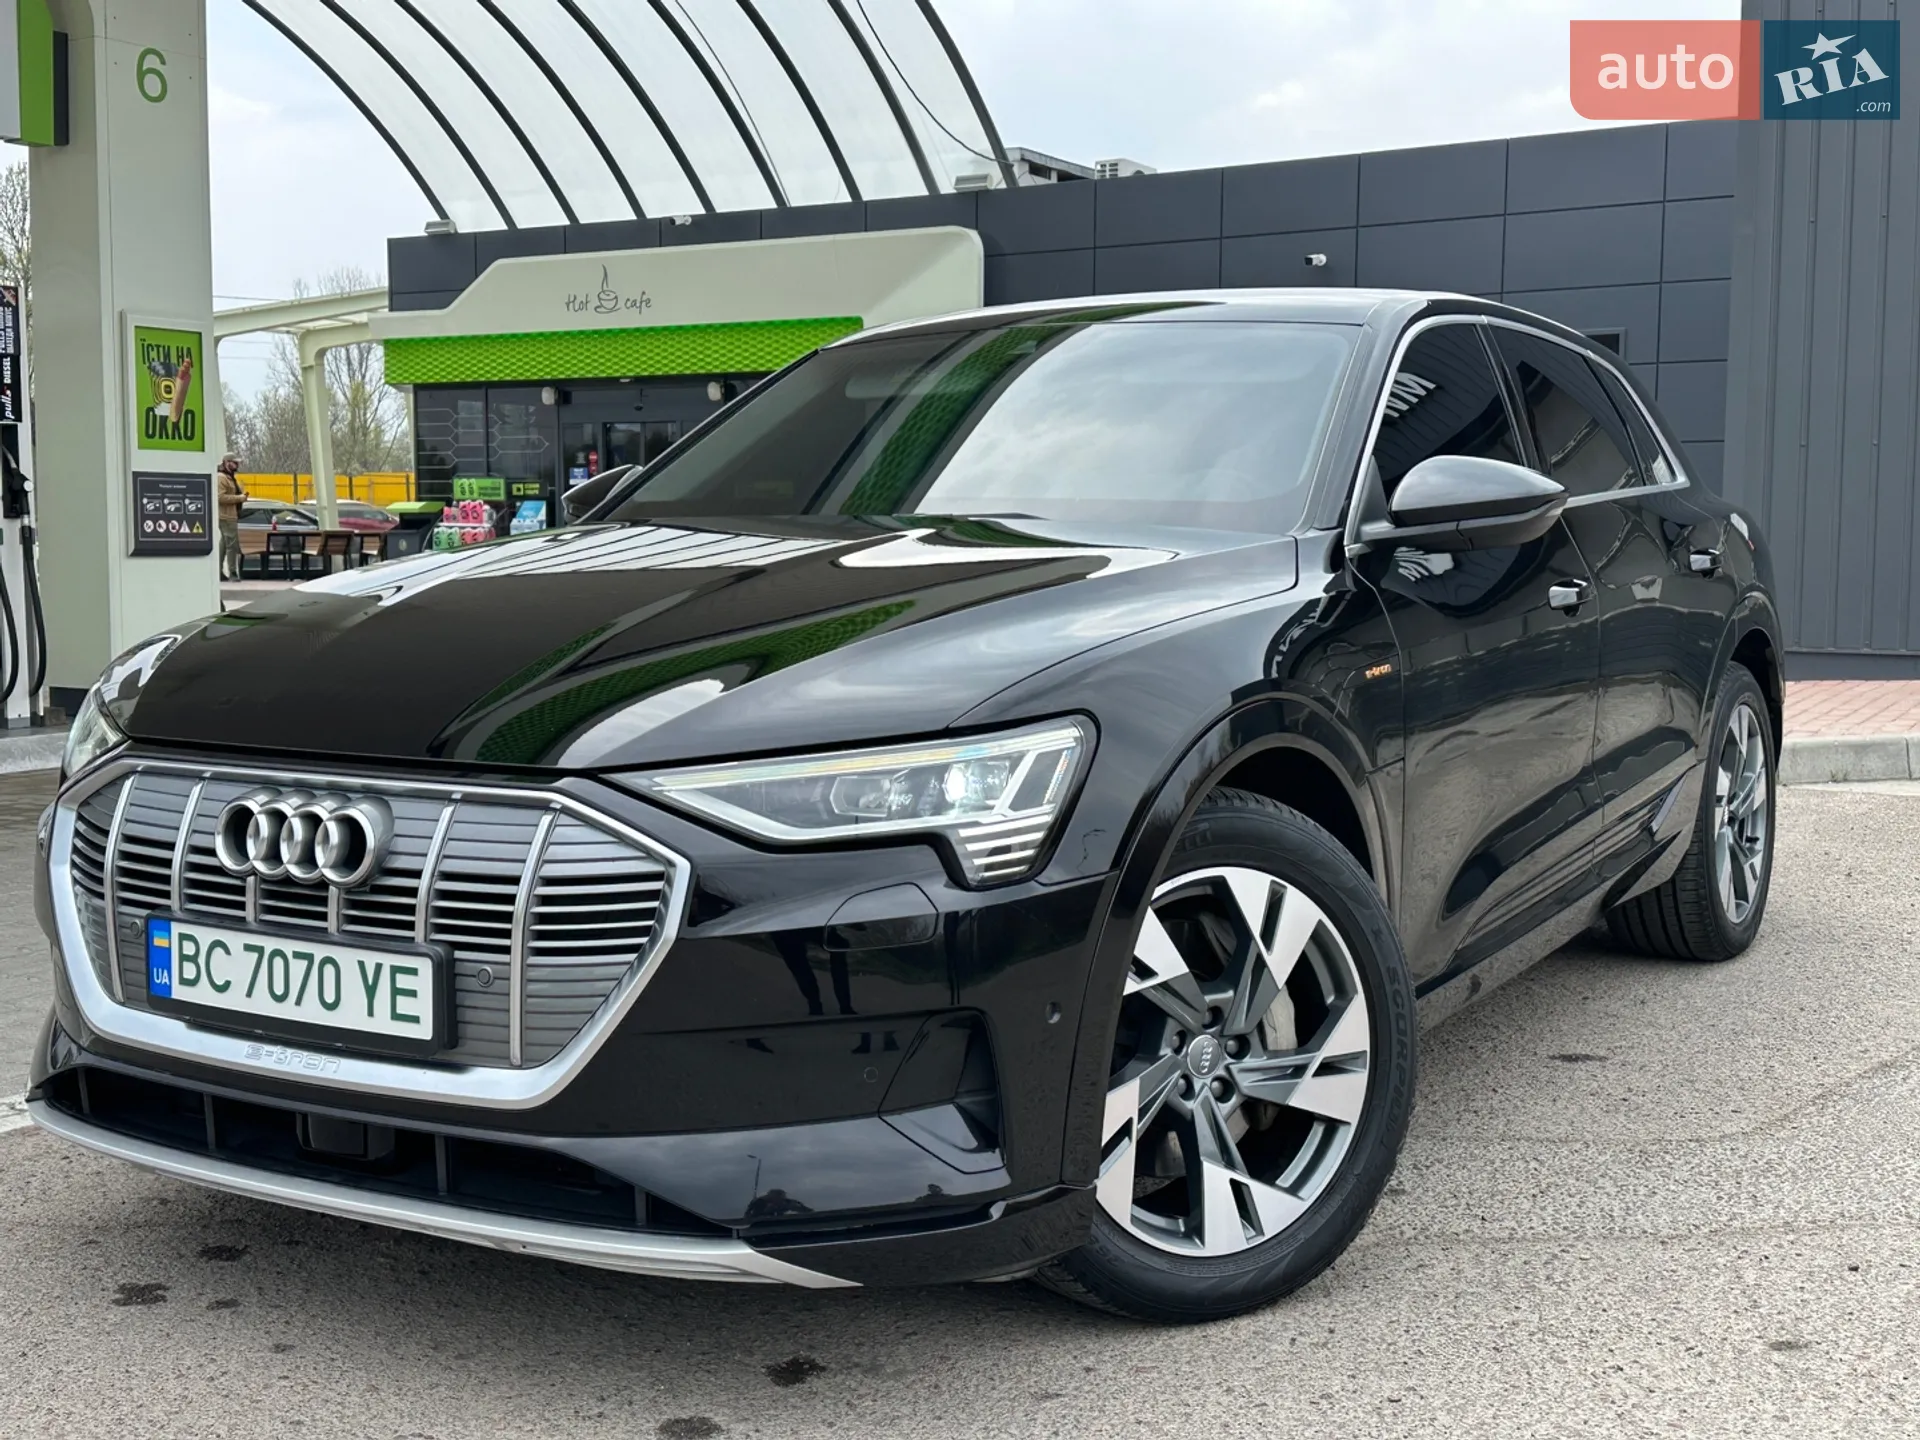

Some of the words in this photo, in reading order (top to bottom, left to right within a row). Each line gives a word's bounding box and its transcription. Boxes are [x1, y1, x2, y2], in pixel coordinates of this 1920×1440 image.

[136, 47, 168, 103] 6
[565, 293, 590, 313] Hot
[624, 290, 652, 315] cafe
[140, 338, 171, 369] ЇСТИ
[176, 345, 194, 369] НА
[3, 357, 11, 384] DIESEL
[1, 389, 15, 419] pulls
[145, 406, 196, 441] ОККО
[153, 966, 170, 986] UA
[178, 931, 232, 993] BC
[243, 943, 341, 1012] 7070
[357, 959, 421, 1025] YE
[244, 1043, 341, 1074] e-tron
